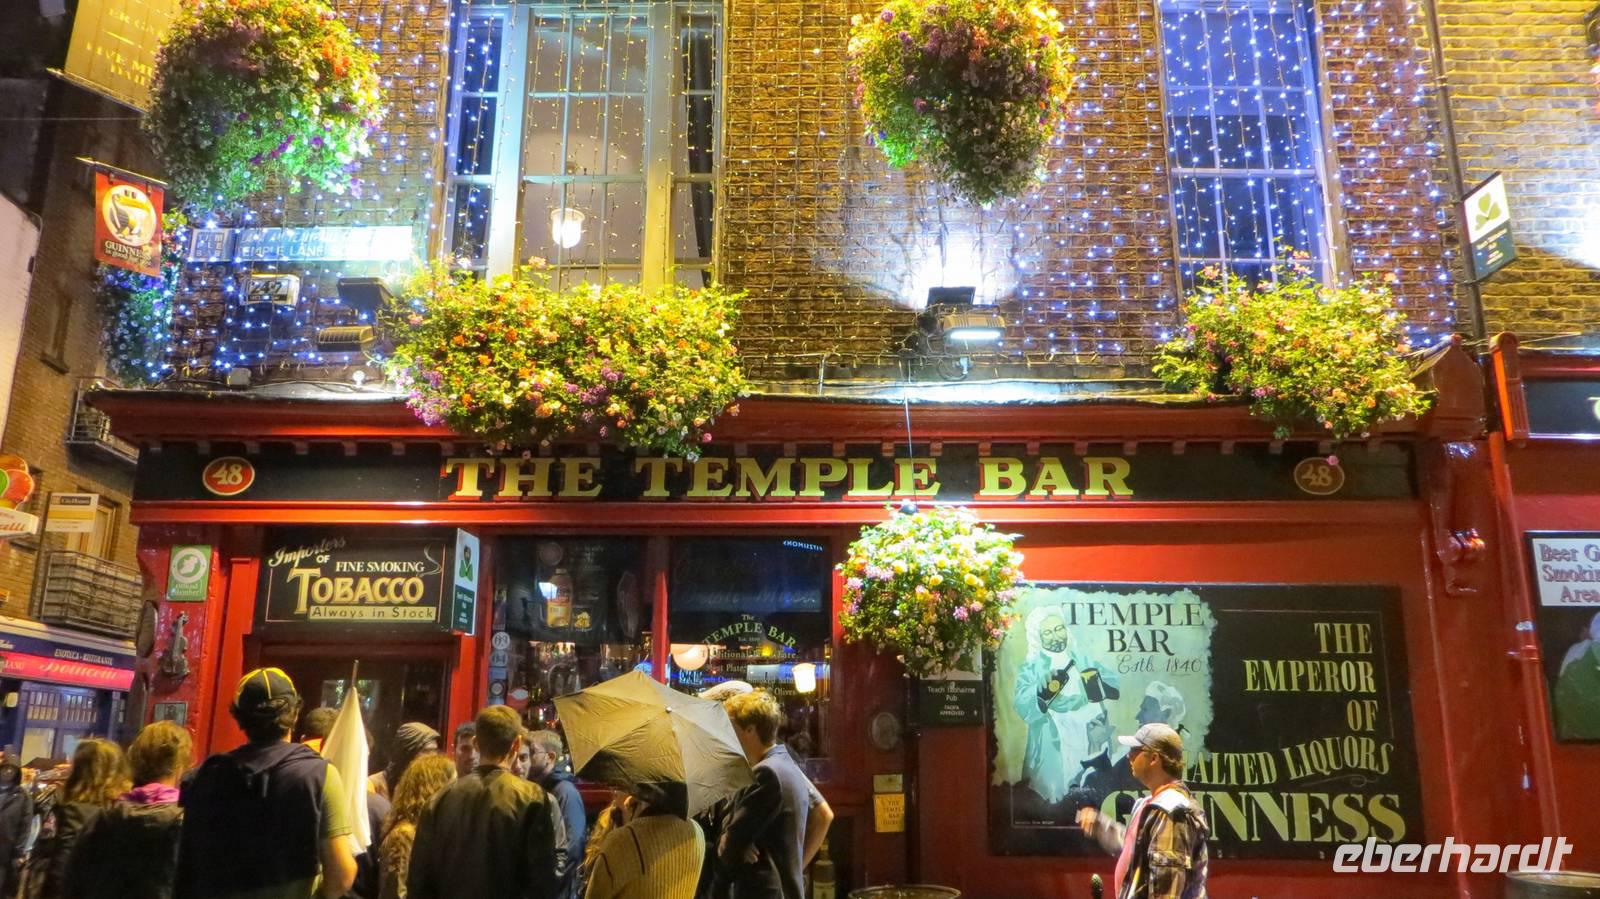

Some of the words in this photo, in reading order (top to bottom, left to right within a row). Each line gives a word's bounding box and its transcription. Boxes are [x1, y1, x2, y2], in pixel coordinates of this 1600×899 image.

[239, 246, 284, 257] EMPLE
[212, 463, 243, 485] 48
[440, 456, 603, 499] THE
[632, 456, 941, 499] TEMPLE
[976, 456, 1134, 499] BAR
[1301, 463, 1333, 486] 48
[268, 537, 347, 567] Importers
[316, 554, 330, 564] OF
[1539, 543, 1579, 562] Beer
[335, 560, 364, 573] FINE
[366, 560, 426, 573] SMOKING
[287, 567, 425, 615] TOBACCO
[311, 606, 365, 619] Always
[372, 607, 386, 618] in
[391, 606, 434, 619] Stock
[1062, 602, 1205, 626] TEMPLE
[702, 622, 763, 646] TEMPLE
[767, 625, 797, 649] BAR
[1106, 629, 1175, 656] BAR
[1314, 622, 1373, 654] THE
[1165, 656, 1201, 673] 1840
[1242, 659, 1377, 693] EMPEROR
[945, 694, 958, 702] Pub
[1346, 699, 1378, 732] OF
[1280, 735, 1395, 780] LIQUORS
[1100, 789, 1407, 843] GNNESS
